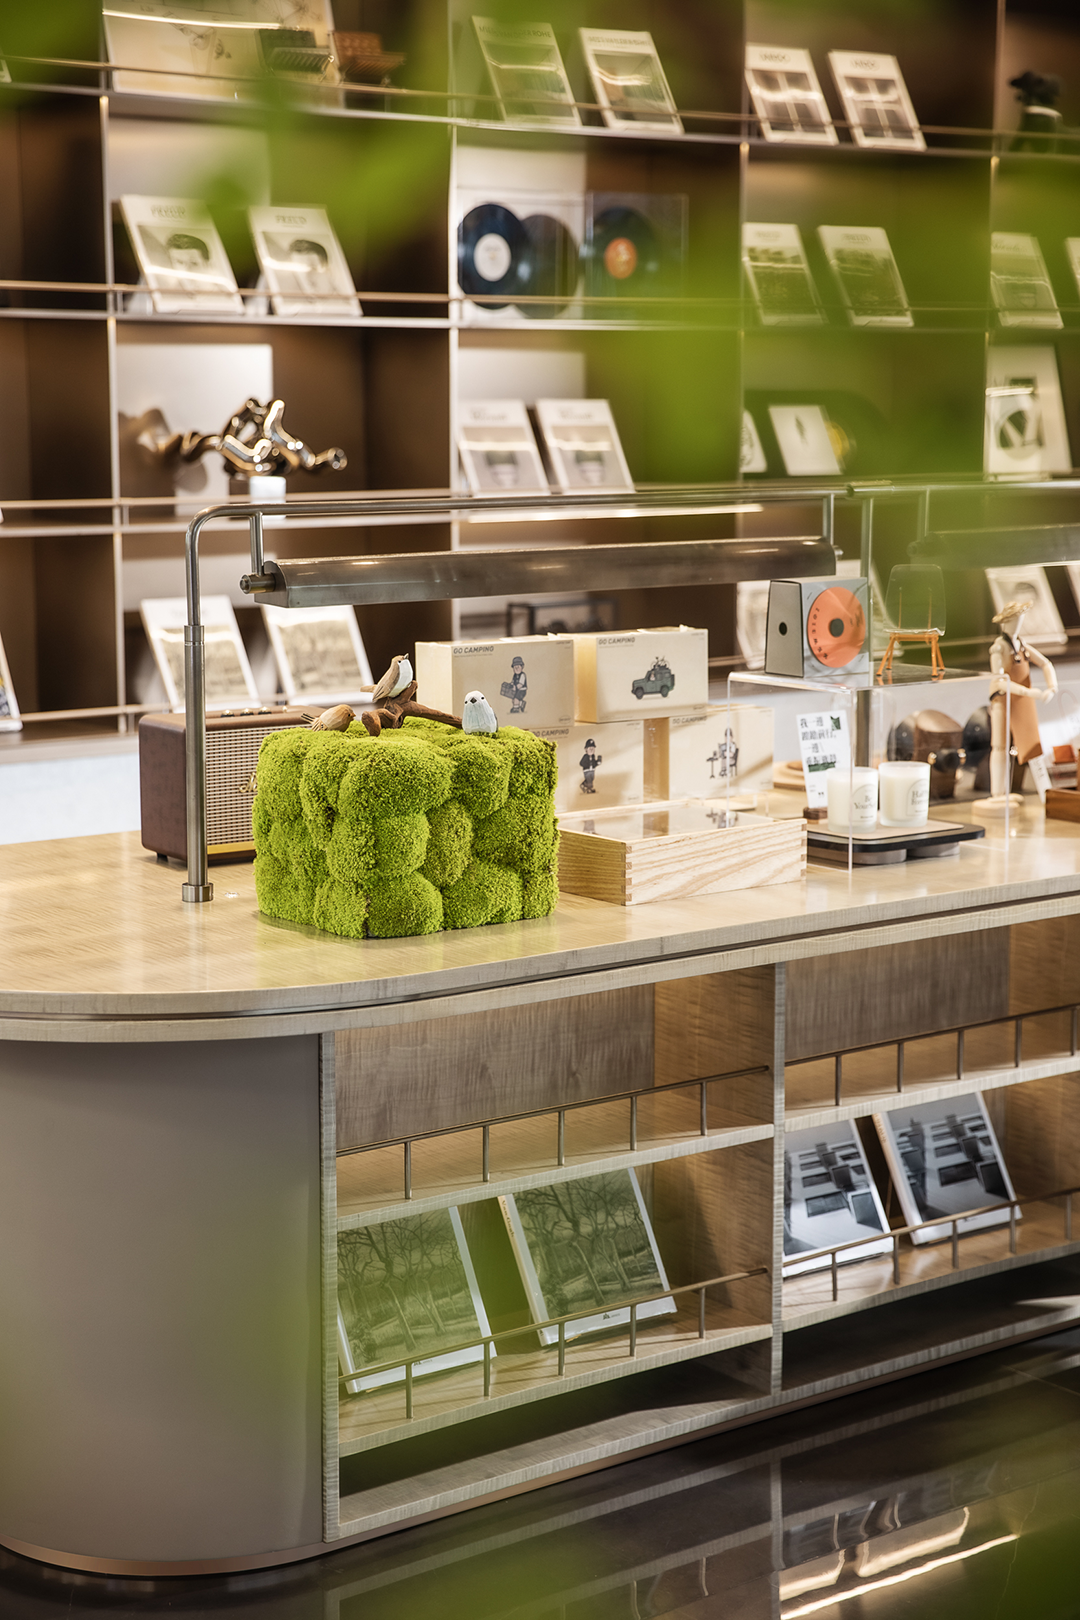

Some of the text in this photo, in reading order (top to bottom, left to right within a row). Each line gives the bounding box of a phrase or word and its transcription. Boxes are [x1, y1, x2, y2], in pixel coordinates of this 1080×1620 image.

[608, 637, 636, 645] CAMPING
[453, 645, 494, 655] GO CAMPING
[681, 715, 707, 724] CAMPING
[541, 728, 569, 737] CAMPING
